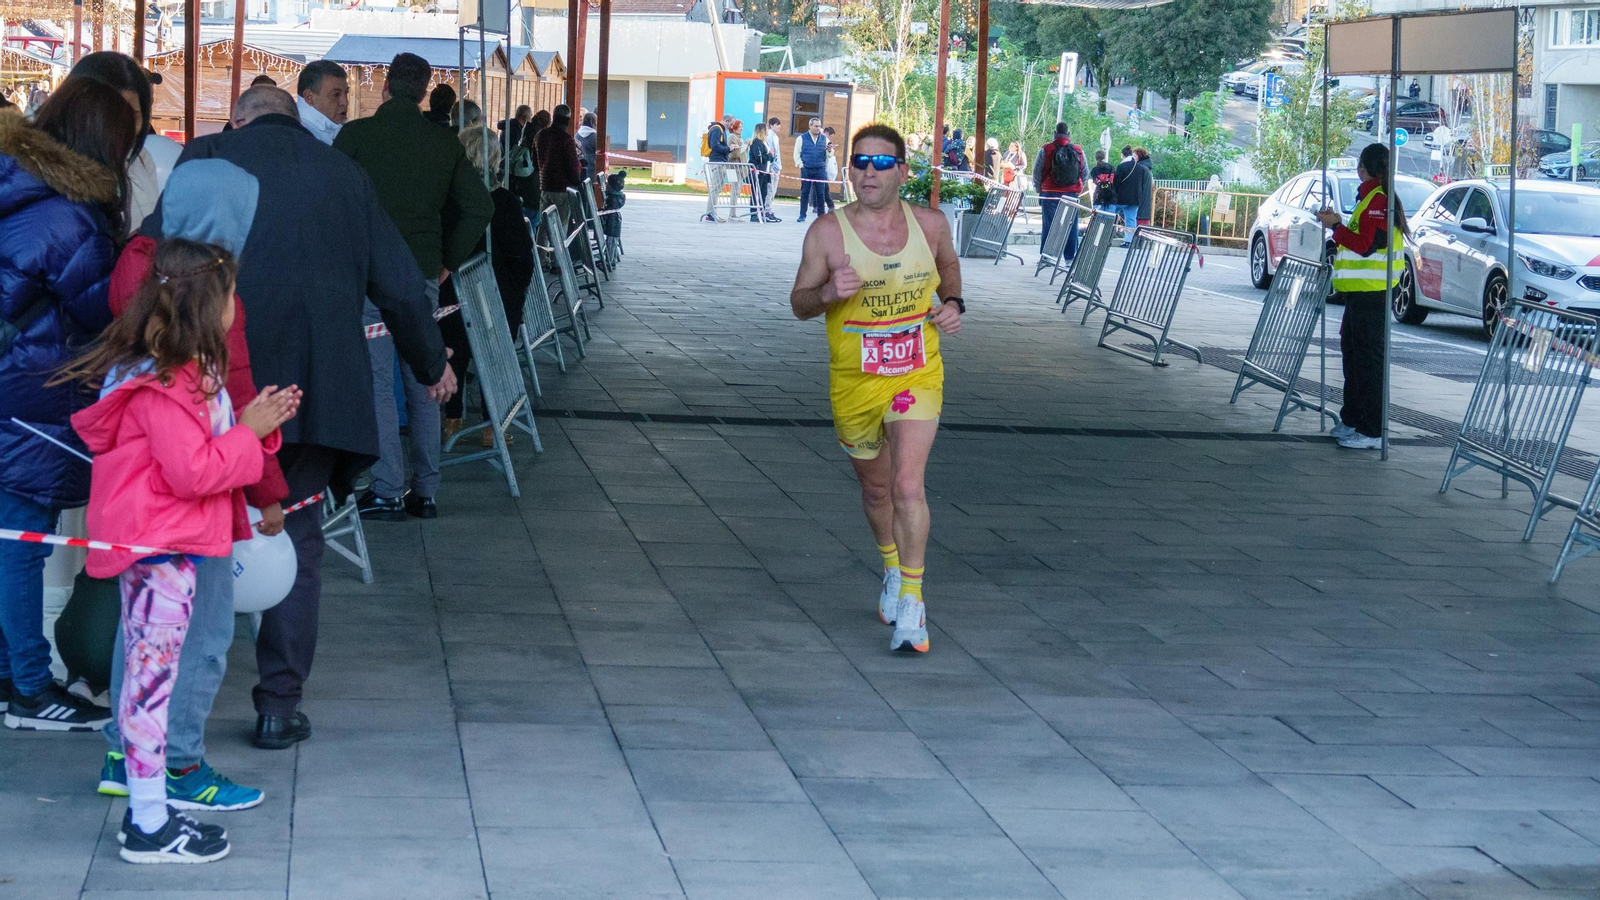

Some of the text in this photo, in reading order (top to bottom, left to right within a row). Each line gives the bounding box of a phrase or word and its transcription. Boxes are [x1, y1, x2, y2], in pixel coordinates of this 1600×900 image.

[1493, 166, 1509, 175] TAXI
[861, 288, 925, 307] ATHLETICS
[871, 304, 916, 318] San Lázaro
[883, 339, 914, 360] 507
[877, 364, 914, 374] Alcampo
